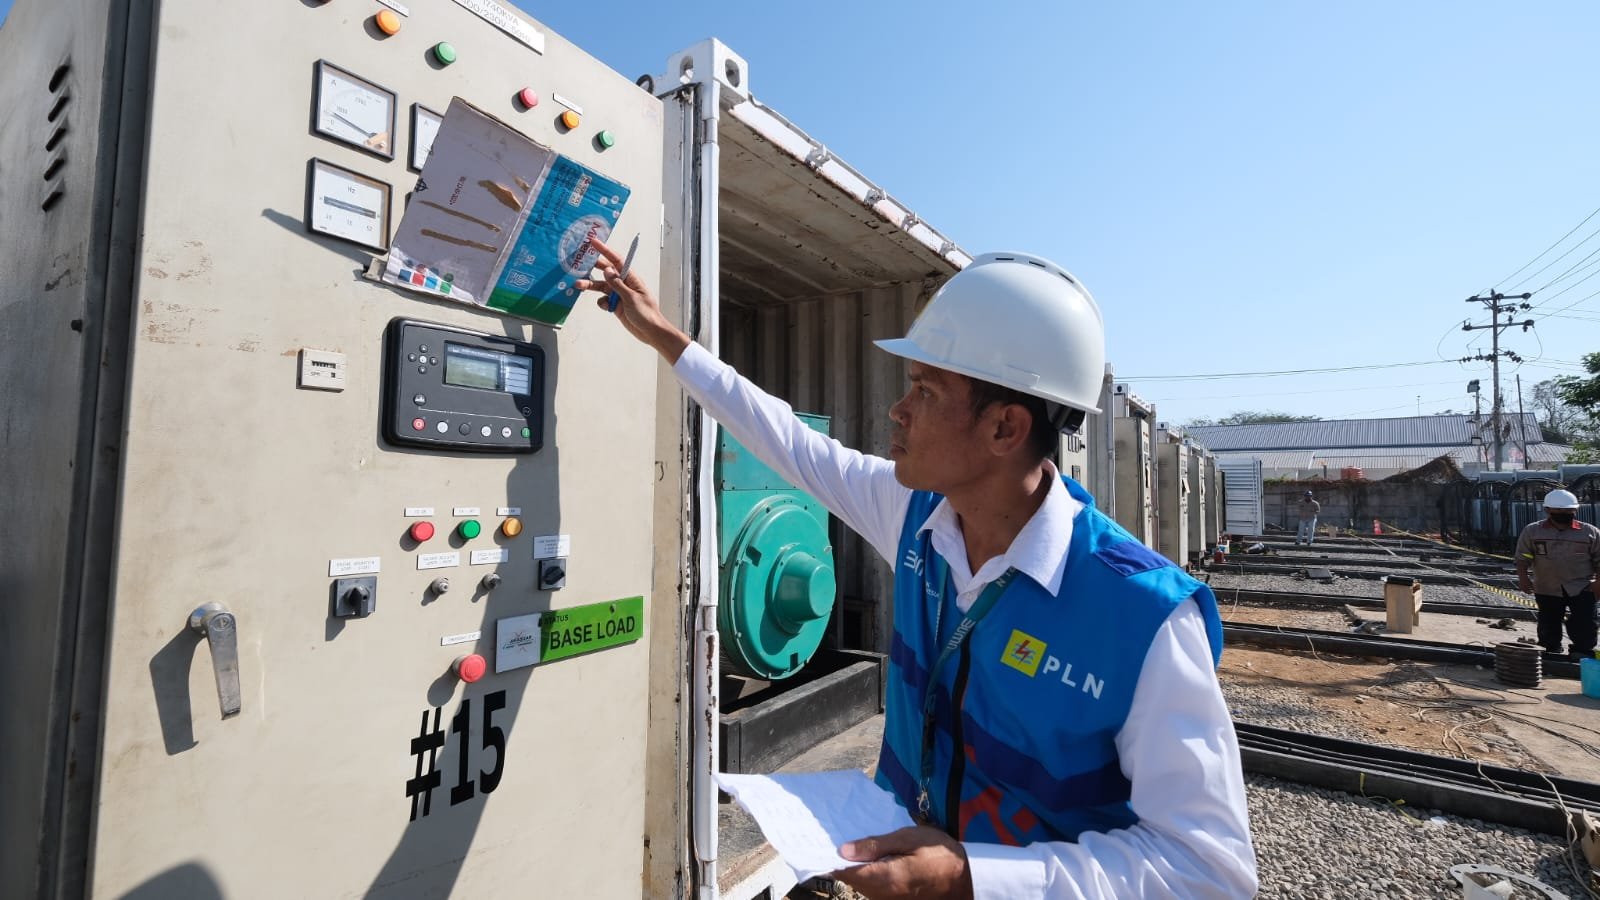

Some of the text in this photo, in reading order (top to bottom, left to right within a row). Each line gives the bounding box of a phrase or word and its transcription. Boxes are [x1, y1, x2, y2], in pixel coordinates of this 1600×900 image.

[571, 221, 602, 270] Minerale
[549, 623, 593, 651] BASE
[597, 615, 636, 641] LOAD
[1042, 654, 1105, 700] PLN
[405, 689, 507, 823] #15
